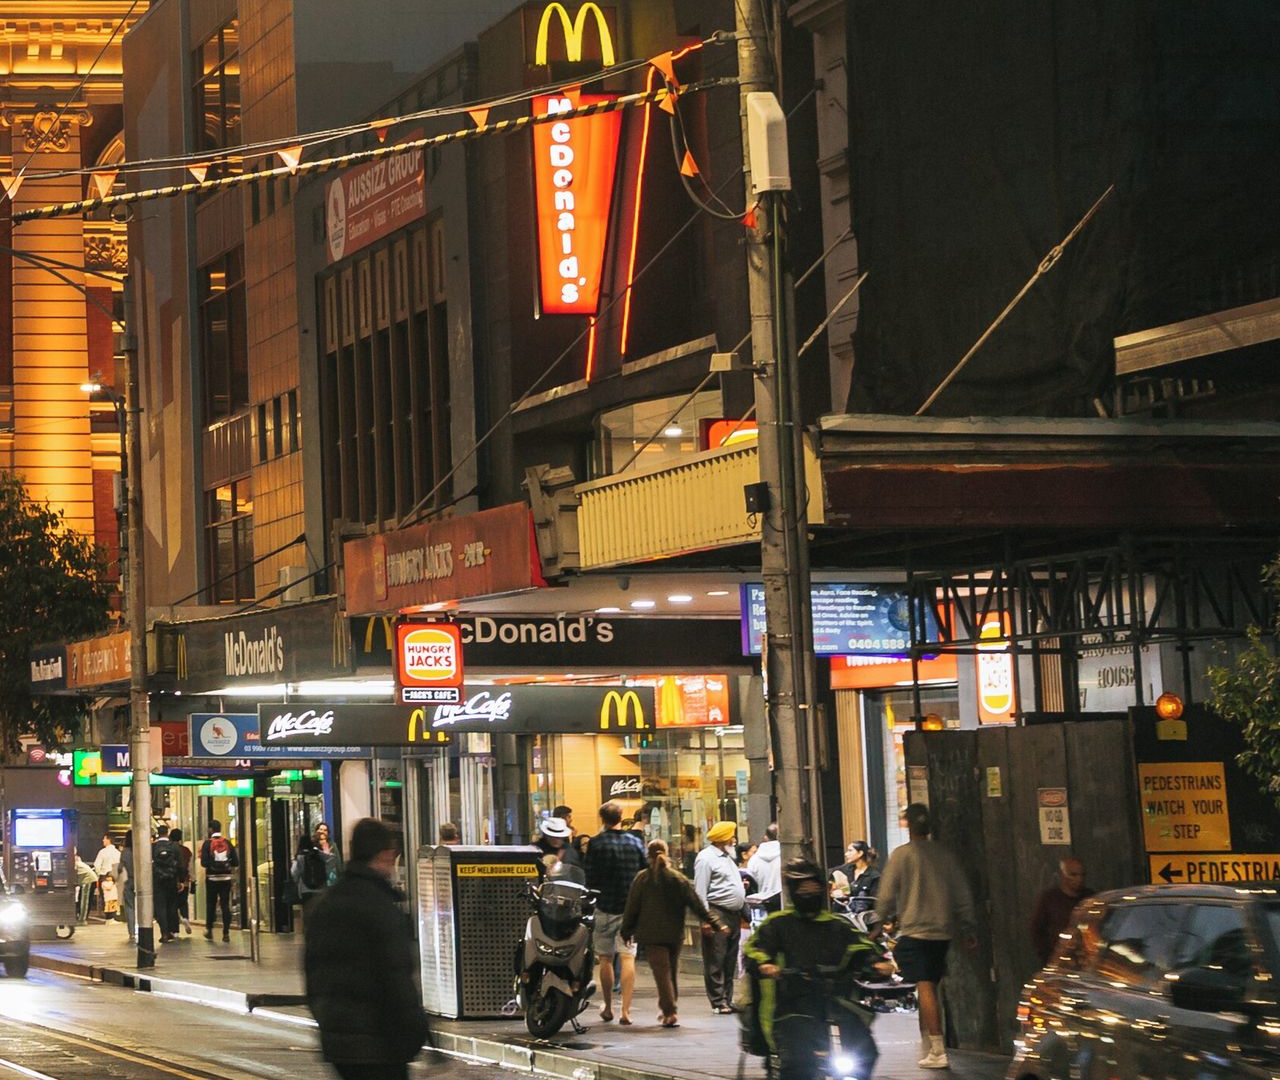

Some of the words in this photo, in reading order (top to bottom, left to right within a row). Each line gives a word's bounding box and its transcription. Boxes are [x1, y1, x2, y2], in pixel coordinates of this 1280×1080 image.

[348, 161, 386, 209] AUSSIZZ
[388, 150, 422, 185] GROUP
[547, 98, 587, 304] McDonald's
[461, 617, 615, 645] cDonald's
[225, 625, 284, 677] McDonald's
[408, 645, 451, 654] HUNGRY
[1143, 775, 1223, 791] PEDESTRIANS
[1146, 800, 1185, 815] WATCH
[1192, 800, 1224, 815] YOUR
[1173, 824, 1201, 839] STEP
[460, 866, 475, 874] KEEP
[516, 866, 536, 874] CLEAN
